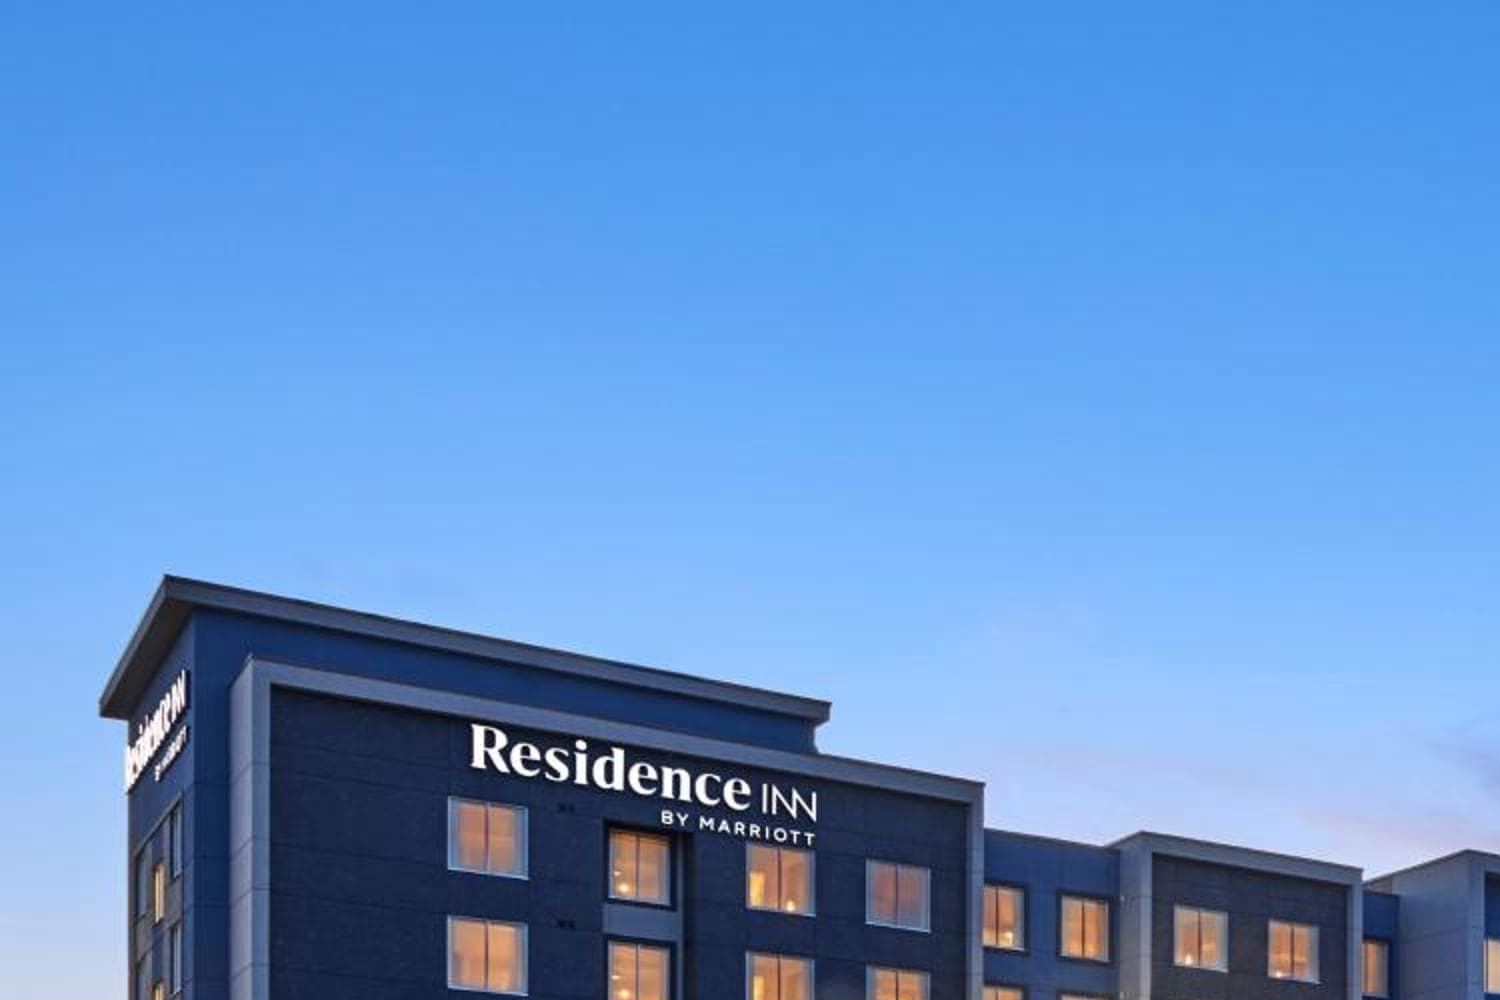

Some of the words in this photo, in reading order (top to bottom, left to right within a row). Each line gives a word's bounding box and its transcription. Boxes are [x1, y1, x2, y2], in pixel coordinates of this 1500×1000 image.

[470, 723, 751, 810] Residence
[762, 783, 818, 822] INN
[661, 810, 689, 826] BY
[699, 816, 816, 847] MARRIOTT
